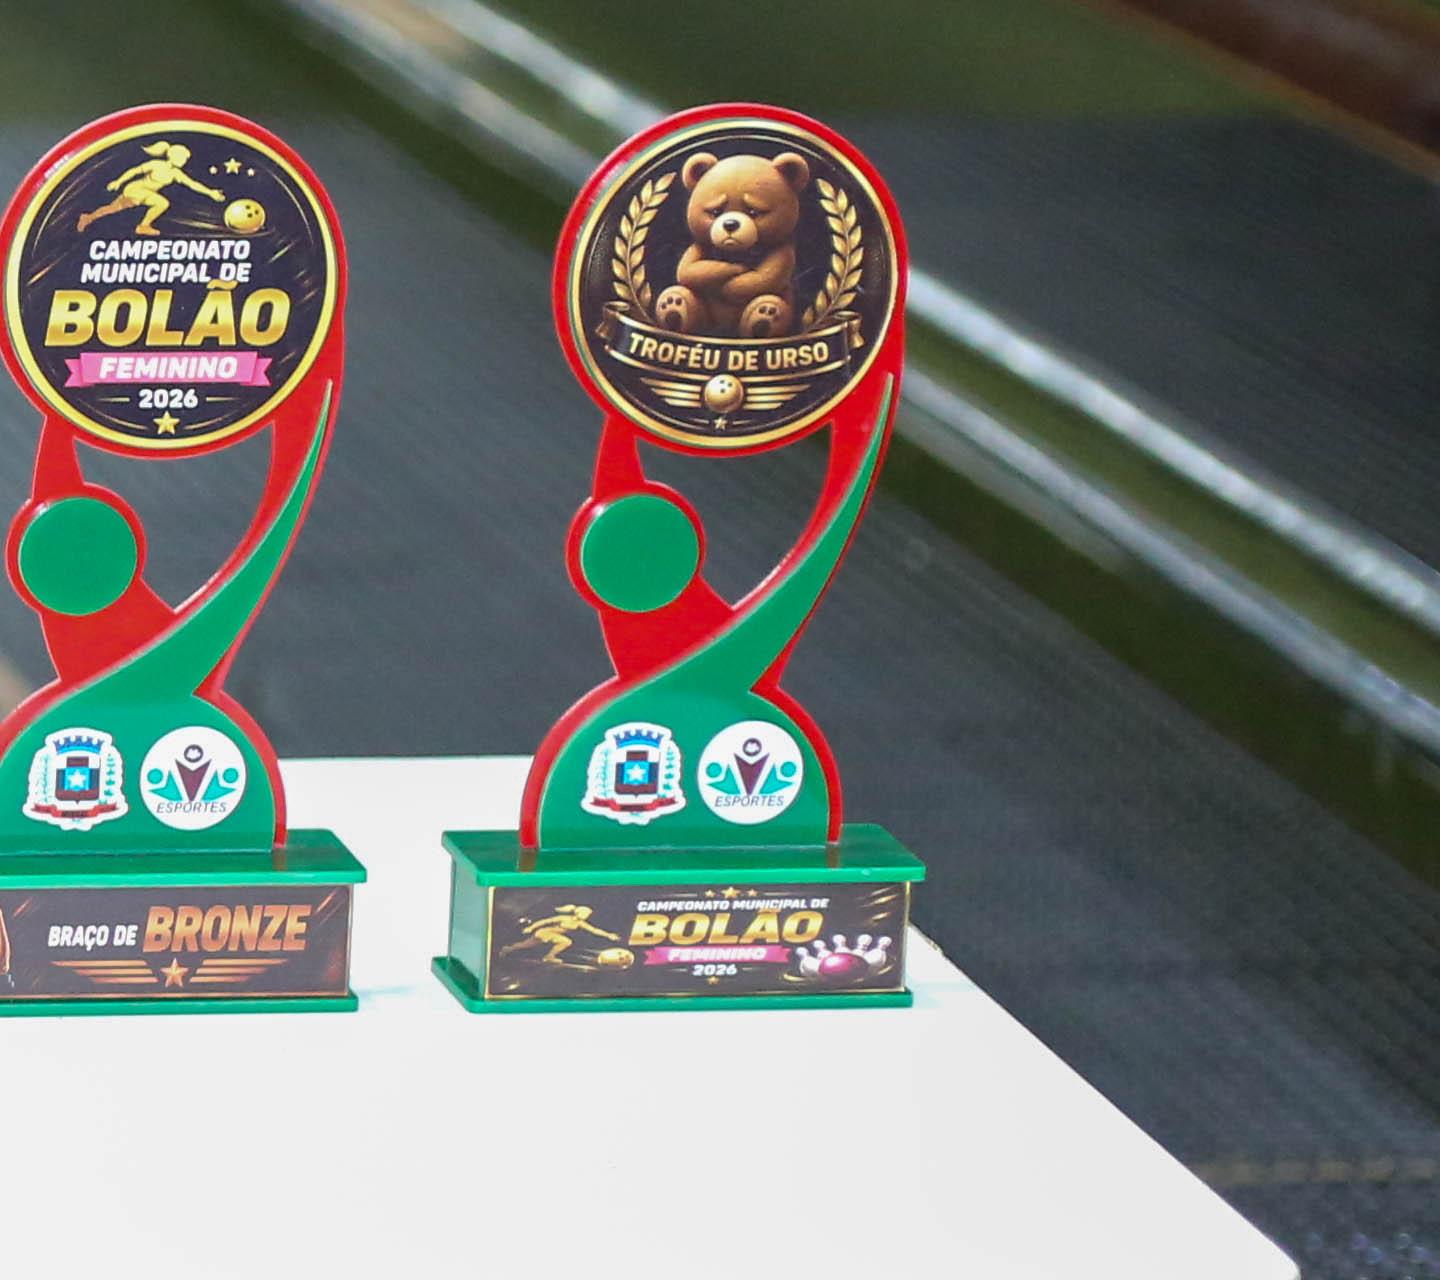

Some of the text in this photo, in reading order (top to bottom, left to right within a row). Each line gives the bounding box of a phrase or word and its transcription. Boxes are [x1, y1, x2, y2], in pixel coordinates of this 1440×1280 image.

[89, 239, 251, 260] CAMPEONATO
[81, 262, 252, 283] MUNICIPAL DE
[44, 279, 291, 348] BOLÃO
[628, 332, 829, 370] TROFÉU DE URSO
[99, 357, 239, 379] FEMININO
[139, 389, 199, 408] 2026
[156, 801, 227, 814] ESPORTES
[714, 795, 784, 808] ESPORTES
[637, 898, 830, 912] CAMPEONATO MUNICIPAL DE
[47, 904, 313, 953] BRAÇO DE BRONZE
[628, 908, 824, 947] BOLÃO
[667, 947, 767, 962] FEMININO
[692, 964, 737, 976] 2026
